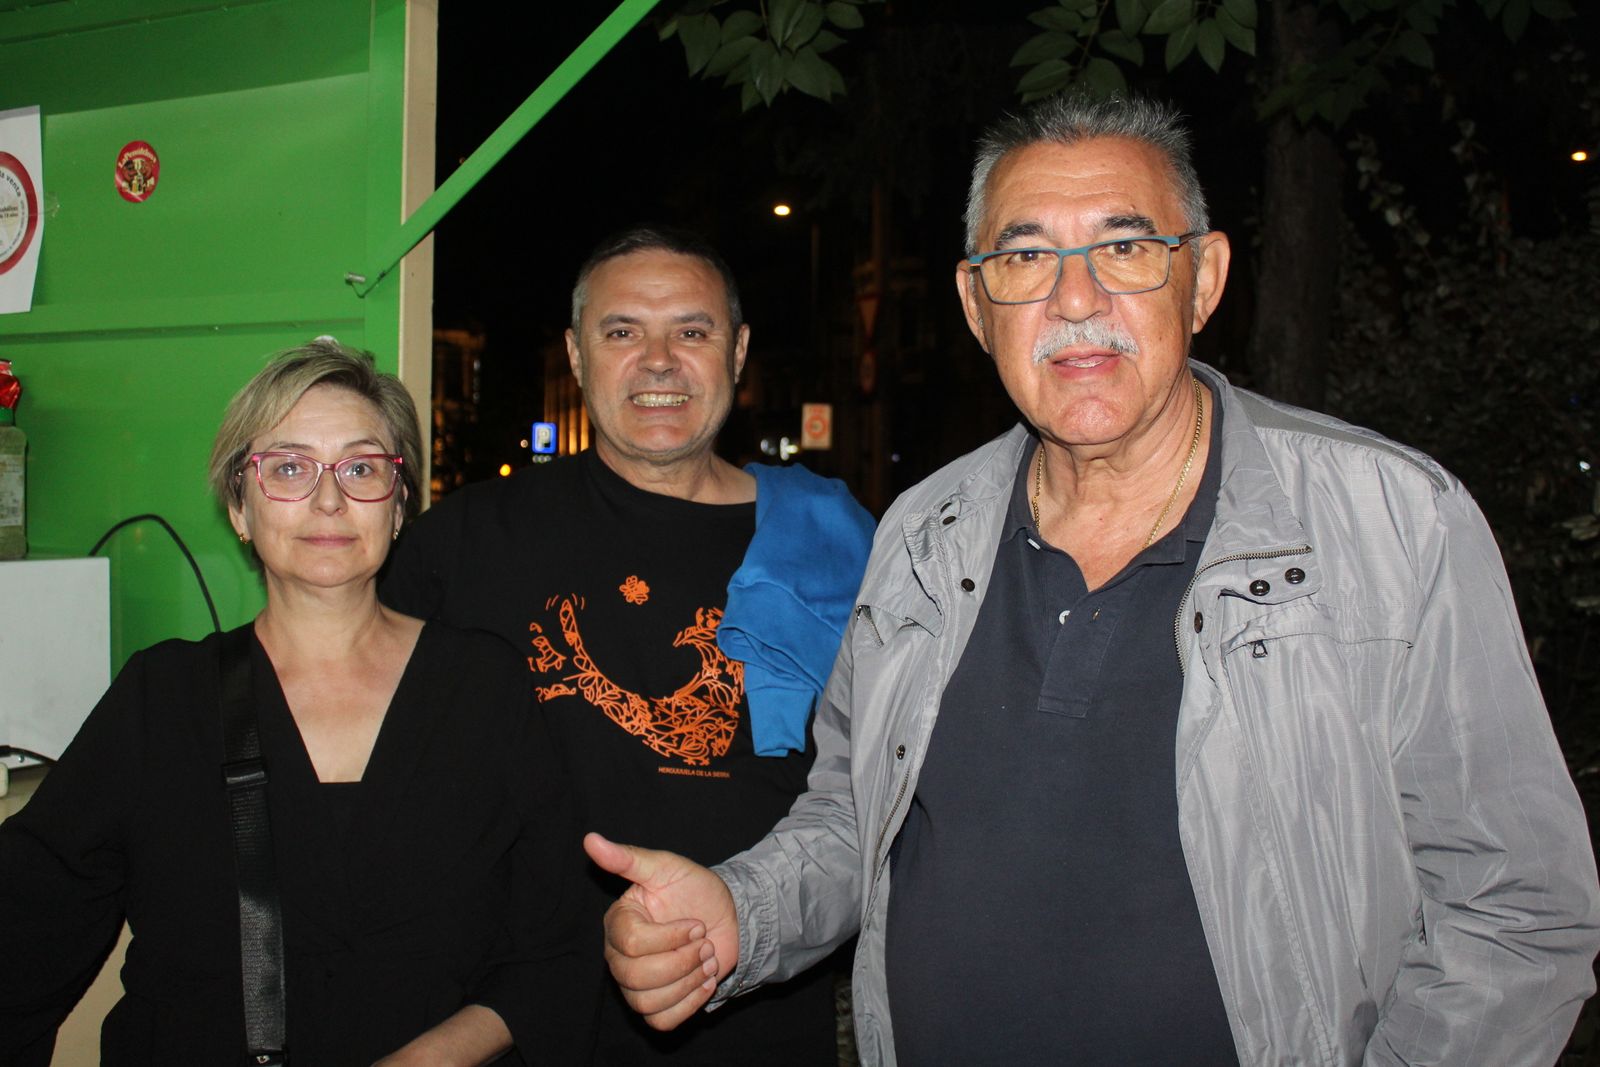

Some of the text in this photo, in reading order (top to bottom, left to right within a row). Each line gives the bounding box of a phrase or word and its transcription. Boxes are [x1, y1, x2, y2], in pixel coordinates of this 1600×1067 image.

[6, 174, 21, 198] venta
[535, 426, 552, 450] P
[696, 769, 704, 777] DE
